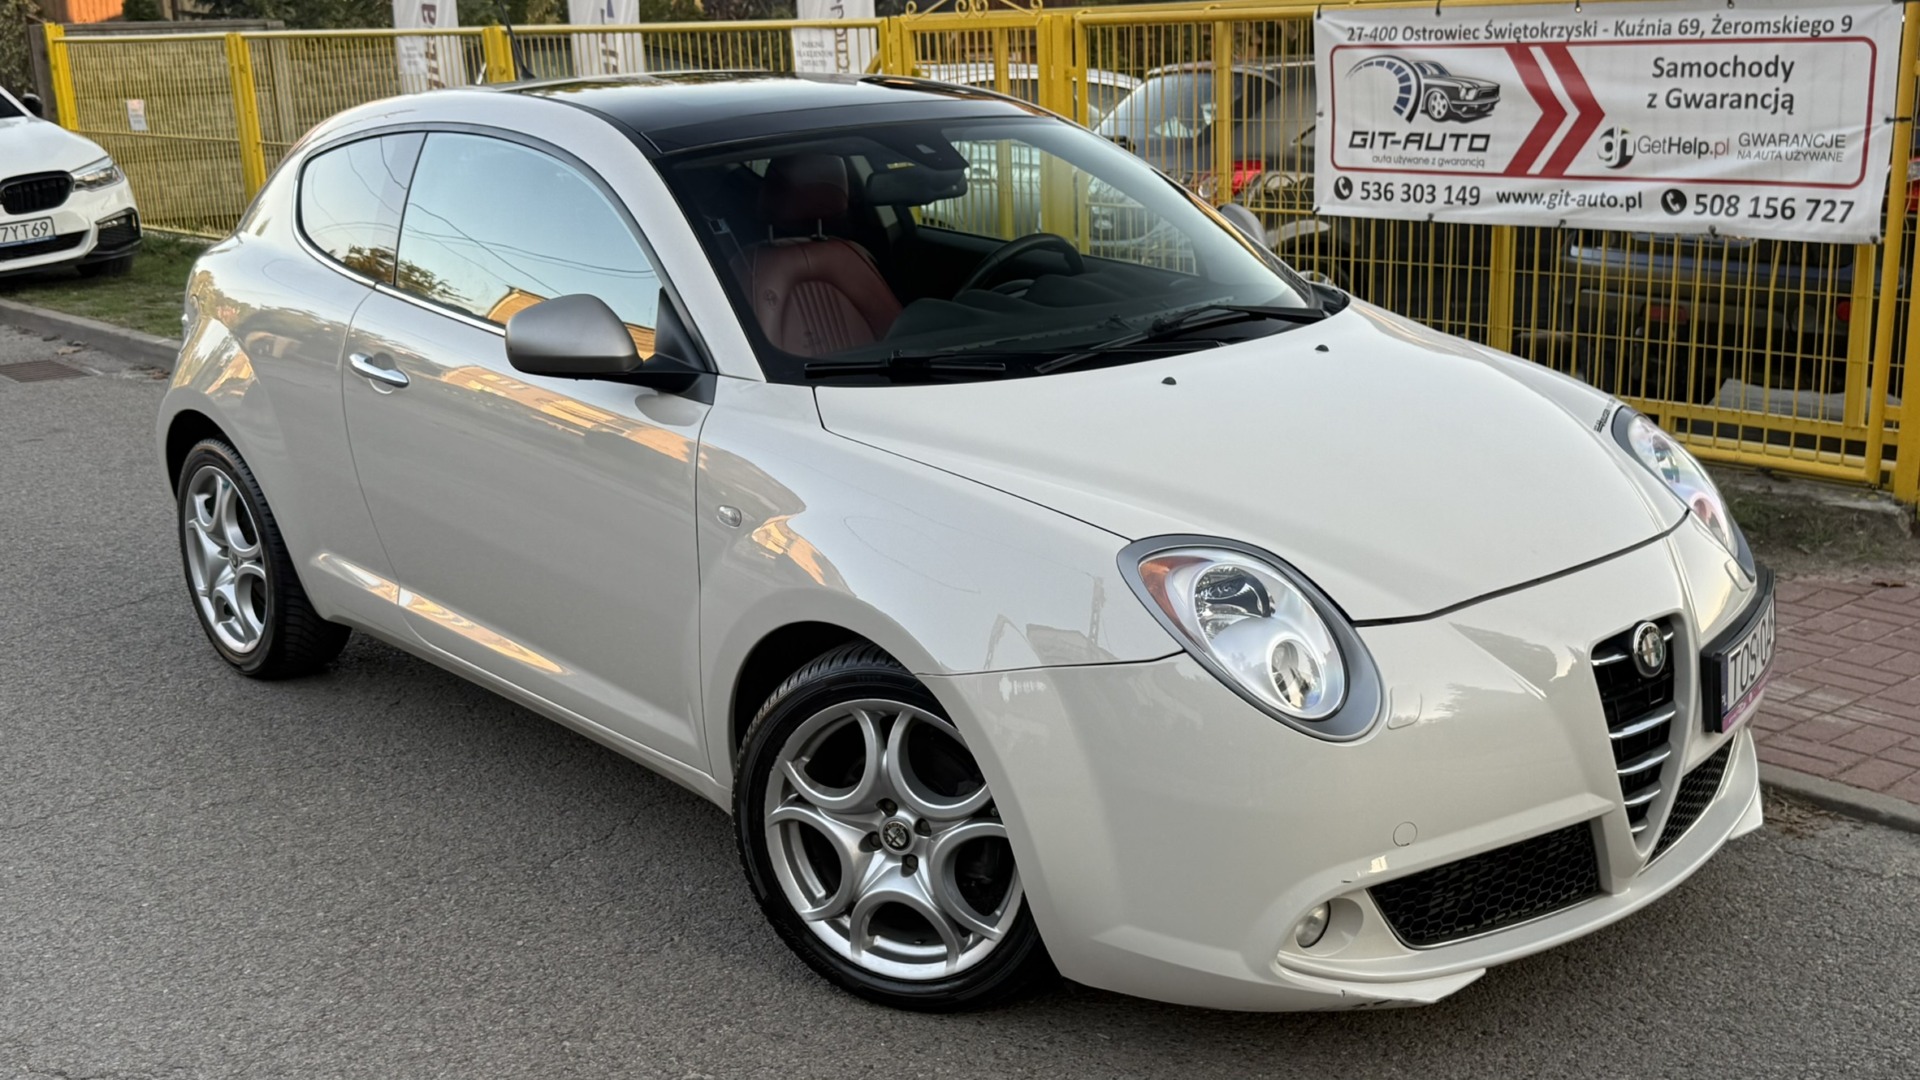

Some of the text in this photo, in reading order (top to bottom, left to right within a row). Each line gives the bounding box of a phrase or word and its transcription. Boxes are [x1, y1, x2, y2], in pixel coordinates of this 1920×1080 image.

[1346, 26, 1398, 42] 27-400
[1402, 25, 1480, 42] Ostrowiec
[1484, 19, 1598, 43] Świętokrzyski
[1613, 18, 1672, 37] Kuźnia
[1677, 18, 1705, 39] 69,
[1711, 14, 1835, 38] Żeromskiego
[1840, 15, 1853, 33] 9
[1652, 54, 1795, 83] Samochody
[1647, 87, 1794, 115] z Gwarancją
[1348, 131, 1491, 152] GIT-AUTO
[1637, 135, 1730, 159] GetHelp.pl
[1738, 132, 1846, 149] GWARANCJE
[1372, 154, 1485, 168] auta używane z gwarancją
[1737, 150, 1844, 162] NA AUTA UŻYWANE
[1360, 181, 1481, 206] 536 303 149
[1496, 189, 1643, 212] www.git-auto.pl
[1693, 194, 1855, 224] 508 156 727
[1730, 630, 1758, 701] TOS
